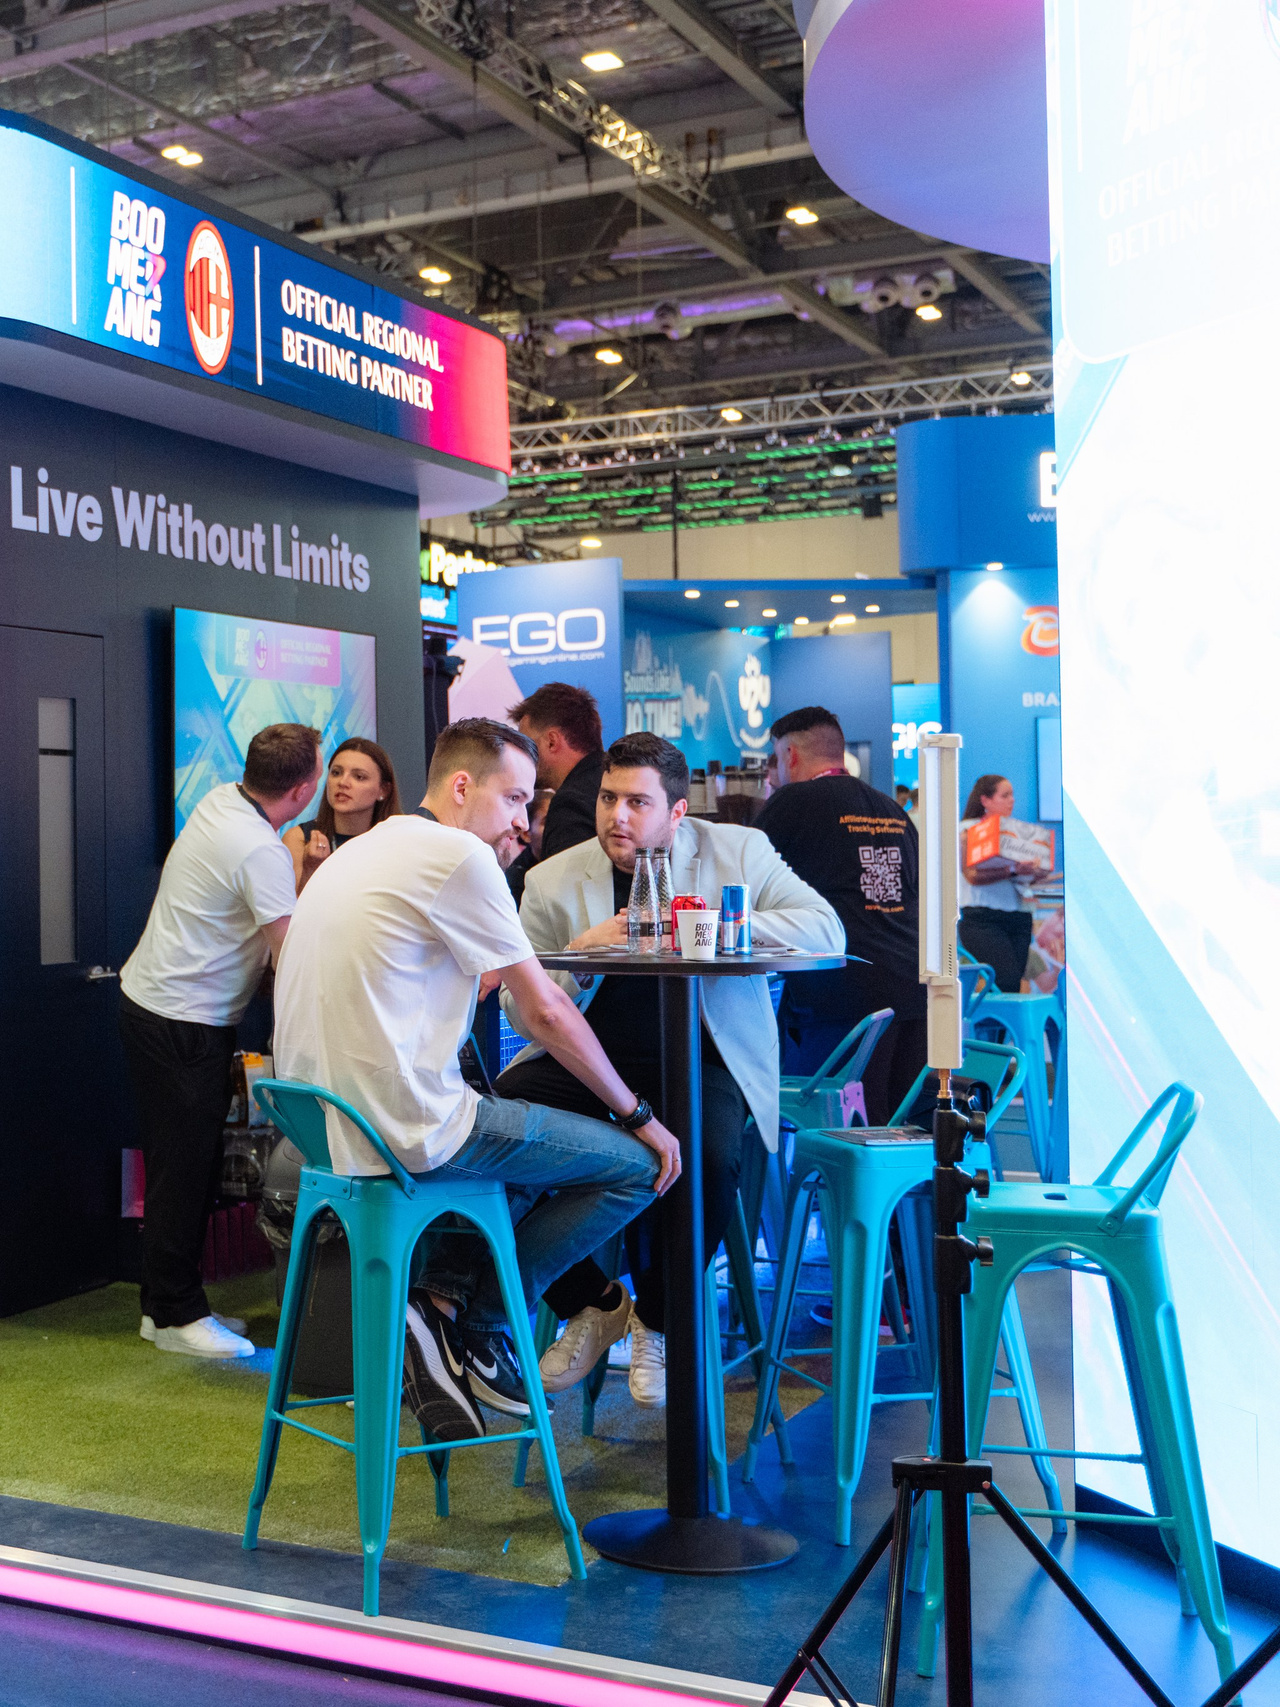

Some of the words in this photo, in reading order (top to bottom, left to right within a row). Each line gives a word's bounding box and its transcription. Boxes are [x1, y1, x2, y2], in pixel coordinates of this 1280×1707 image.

[1098, 142, 1219, 221] OFFICIAL
[111, 190, 166, 255] BOO
[1107, 193, 1221, 268] BETTING
[104, 286, 162, 348] ANG
[280, 279, 361, 342] OFFICIAL
[362, 311, 444, 373] REGIONAL
[282, 326, 358, 385] BETTING
[360, 356, 434, 412] PARTNER
[10, 465, 103, 542] Live
[111, 486, 268, 574] Without
[272, 523, 371, 592] Limits
